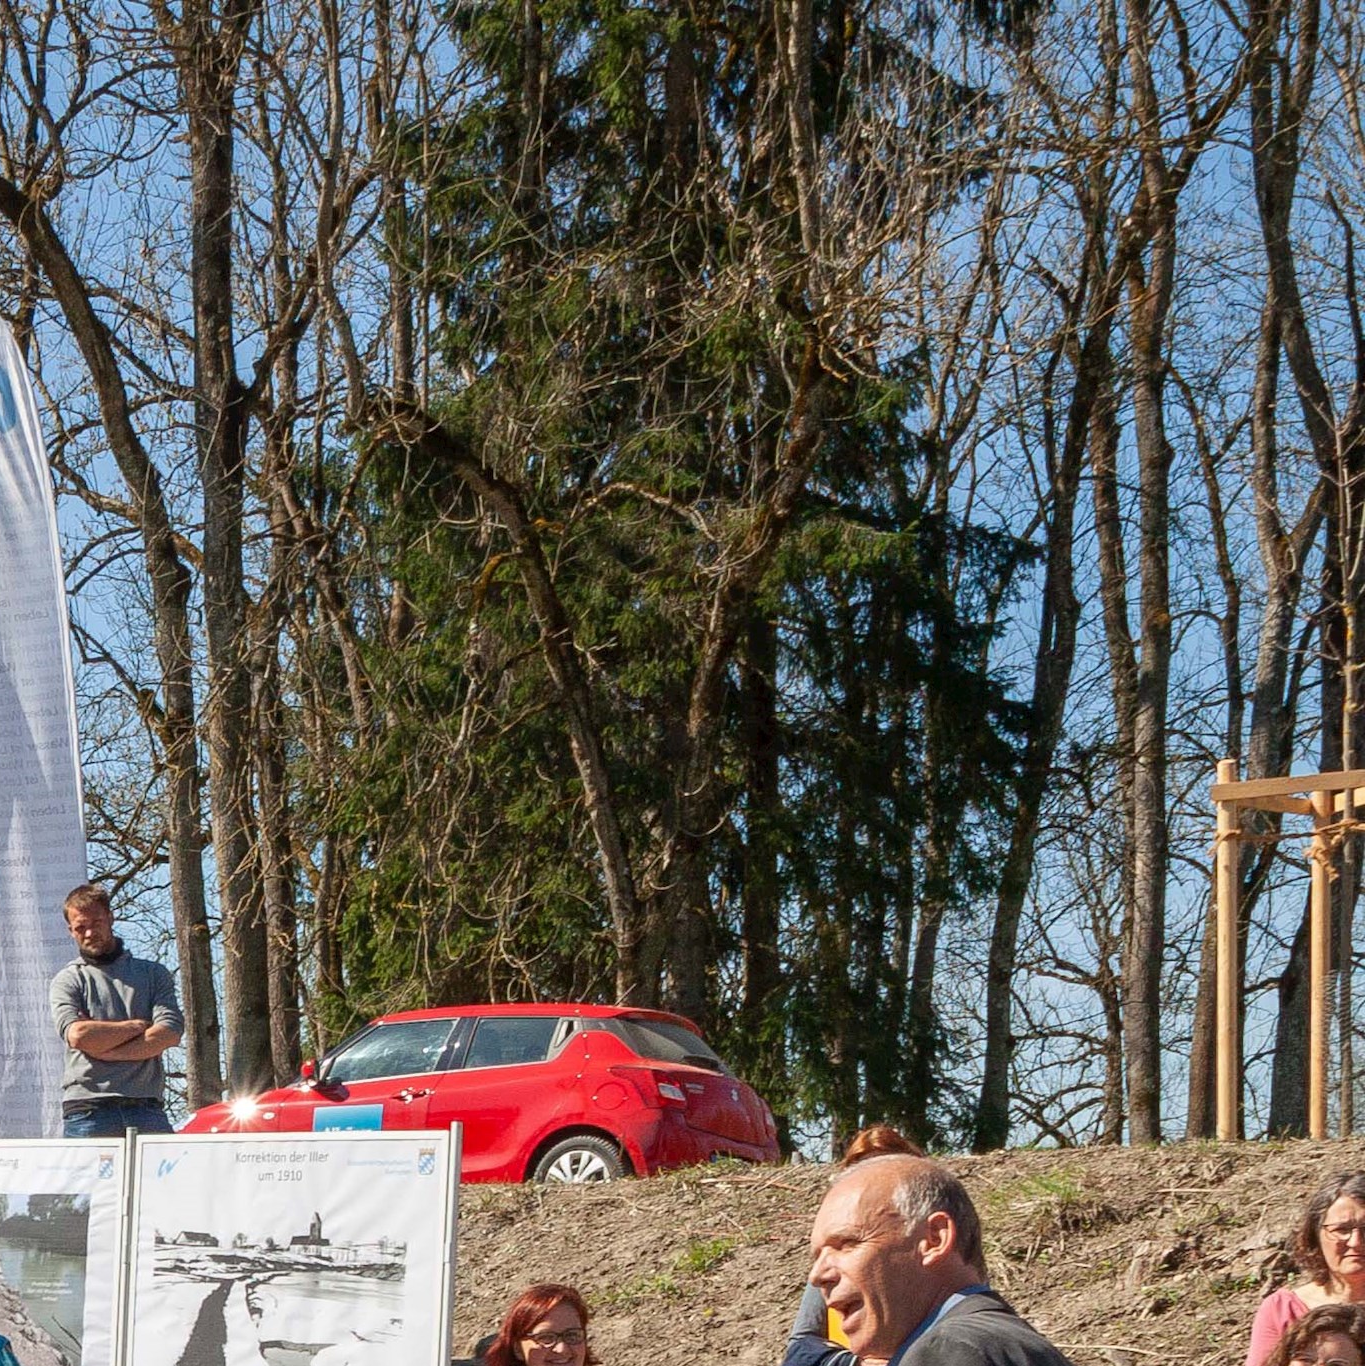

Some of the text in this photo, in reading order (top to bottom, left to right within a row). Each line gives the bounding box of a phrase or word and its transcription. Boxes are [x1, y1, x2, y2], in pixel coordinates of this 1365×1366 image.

[235, 1151, 329, 1163] Korrektion der Iller
[258, 1170, 303, 1182] um 1910
